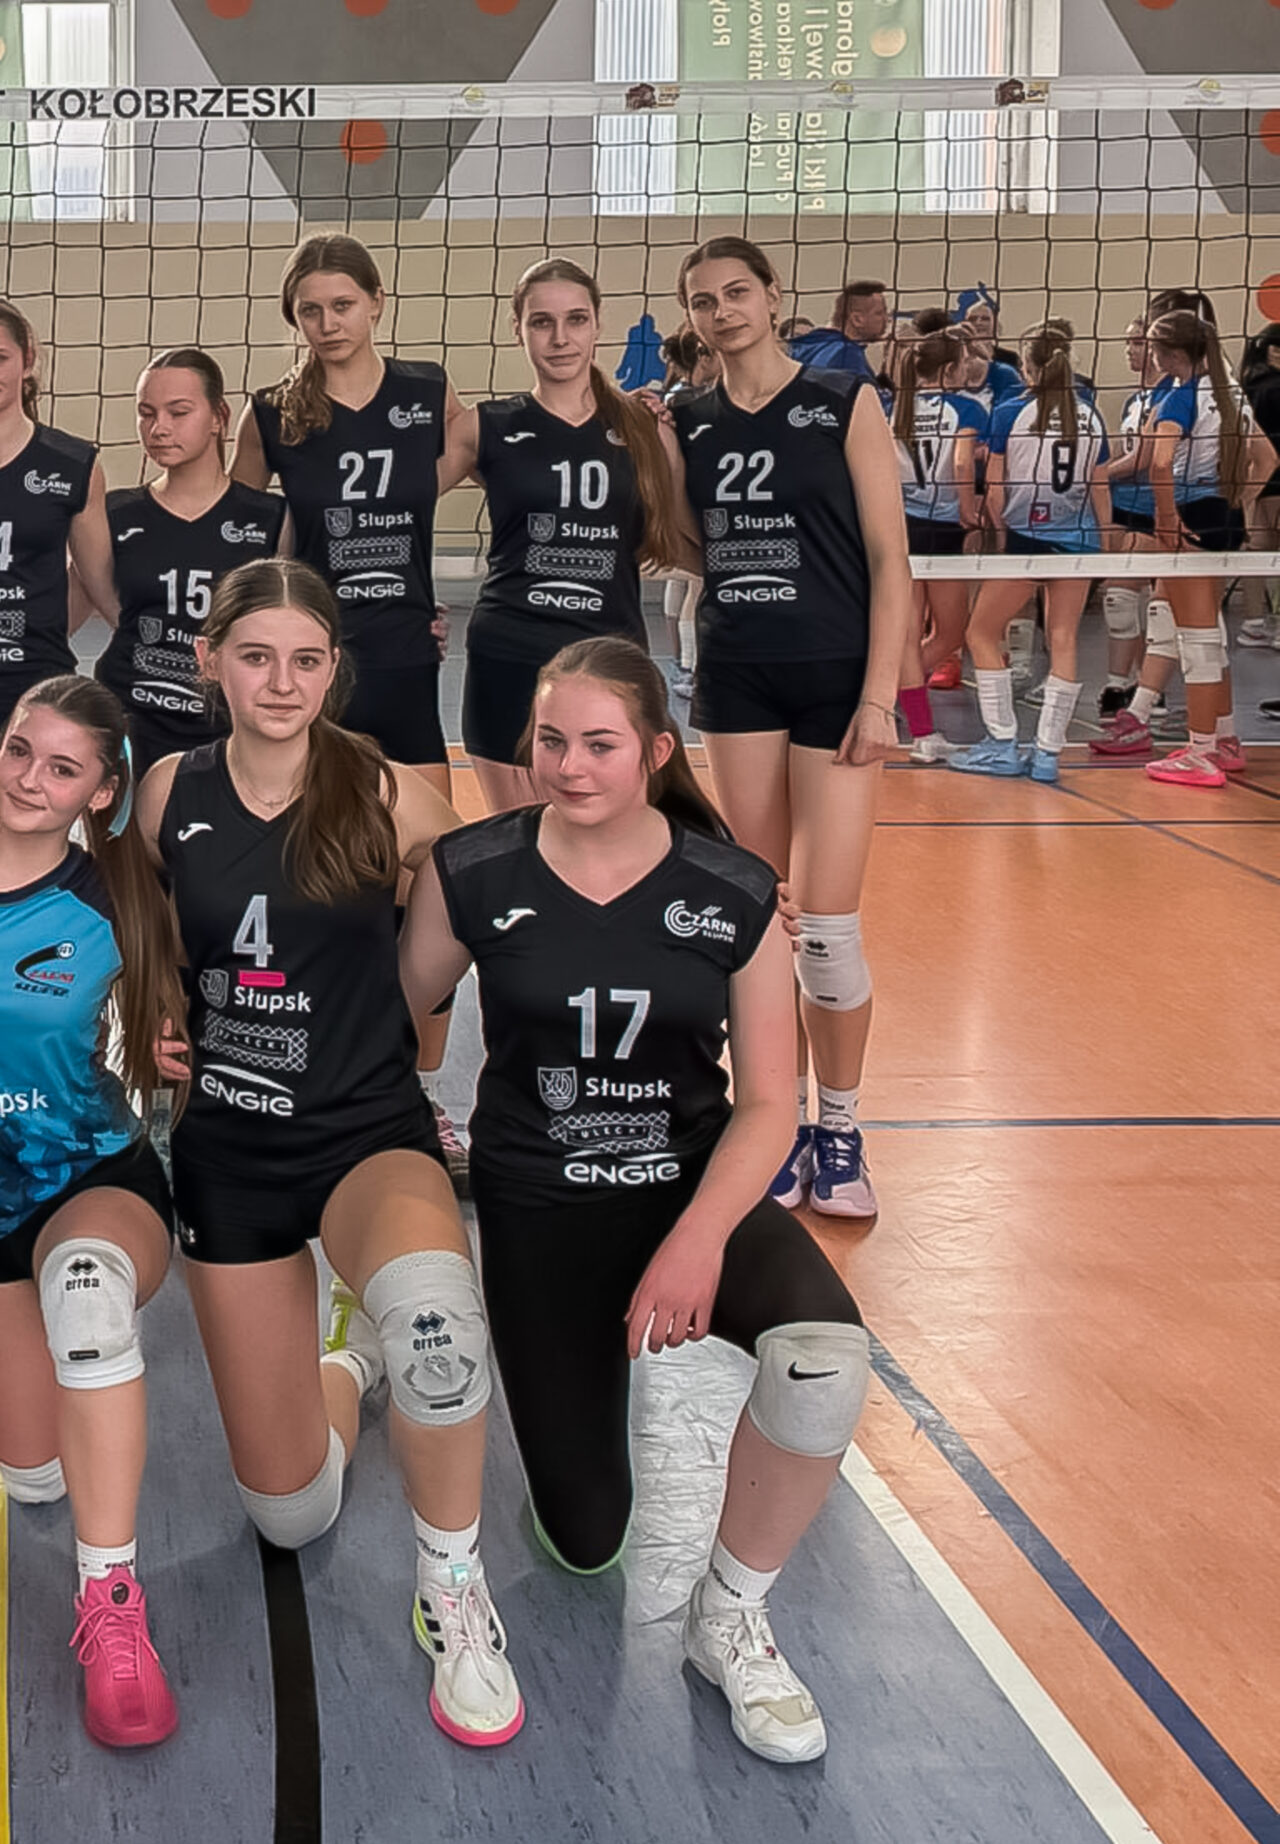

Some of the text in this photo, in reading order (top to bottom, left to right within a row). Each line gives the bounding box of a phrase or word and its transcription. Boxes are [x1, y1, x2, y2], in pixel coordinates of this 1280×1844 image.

[30, 87, 316, 119] KOŁOBRZESKI
[338, 449, 393, 501] 27
[550, 459, 610, 510] 10
[715, 449, 775, 502] 22
[734, 513, 797, 532] Słupsk
[158, 568, 213, 620] 15
[166, 628, 197, 646] Słu
[232, 894, 274, 968] 4
[234, 986, 311, 1014] Słupsk
[567, 986, 651, 1060] 17
[585, 1077, 673, 1103] Słupsk
[568, 1124, 648, 1139] ULECKI
